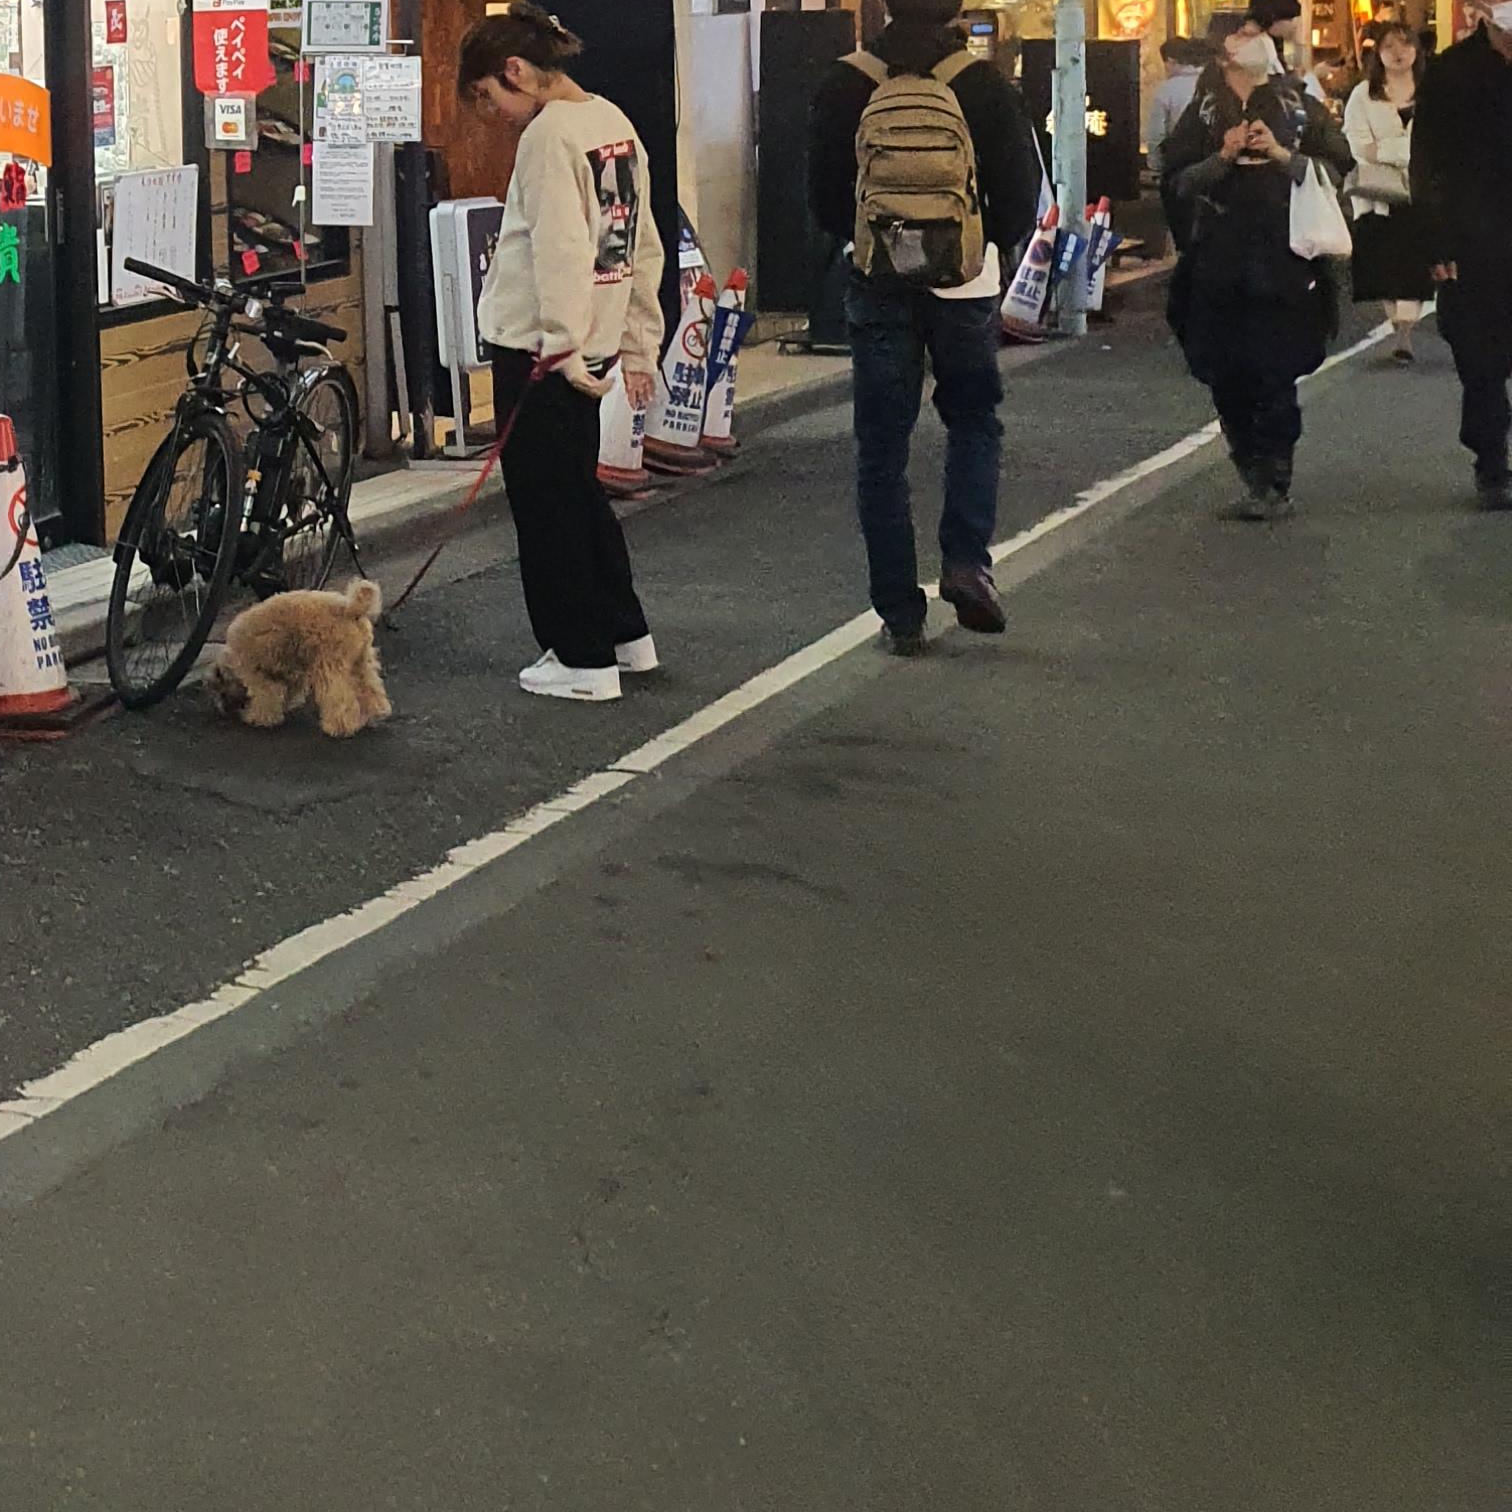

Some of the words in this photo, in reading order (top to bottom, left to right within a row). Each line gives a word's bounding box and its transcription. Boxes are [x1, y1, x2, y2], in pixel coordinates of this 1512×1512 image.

[213, 27, 229, 95] 使えます
[231, 15, 246, 80] ペイペイ
[219, 104, 242, 115] VISA
